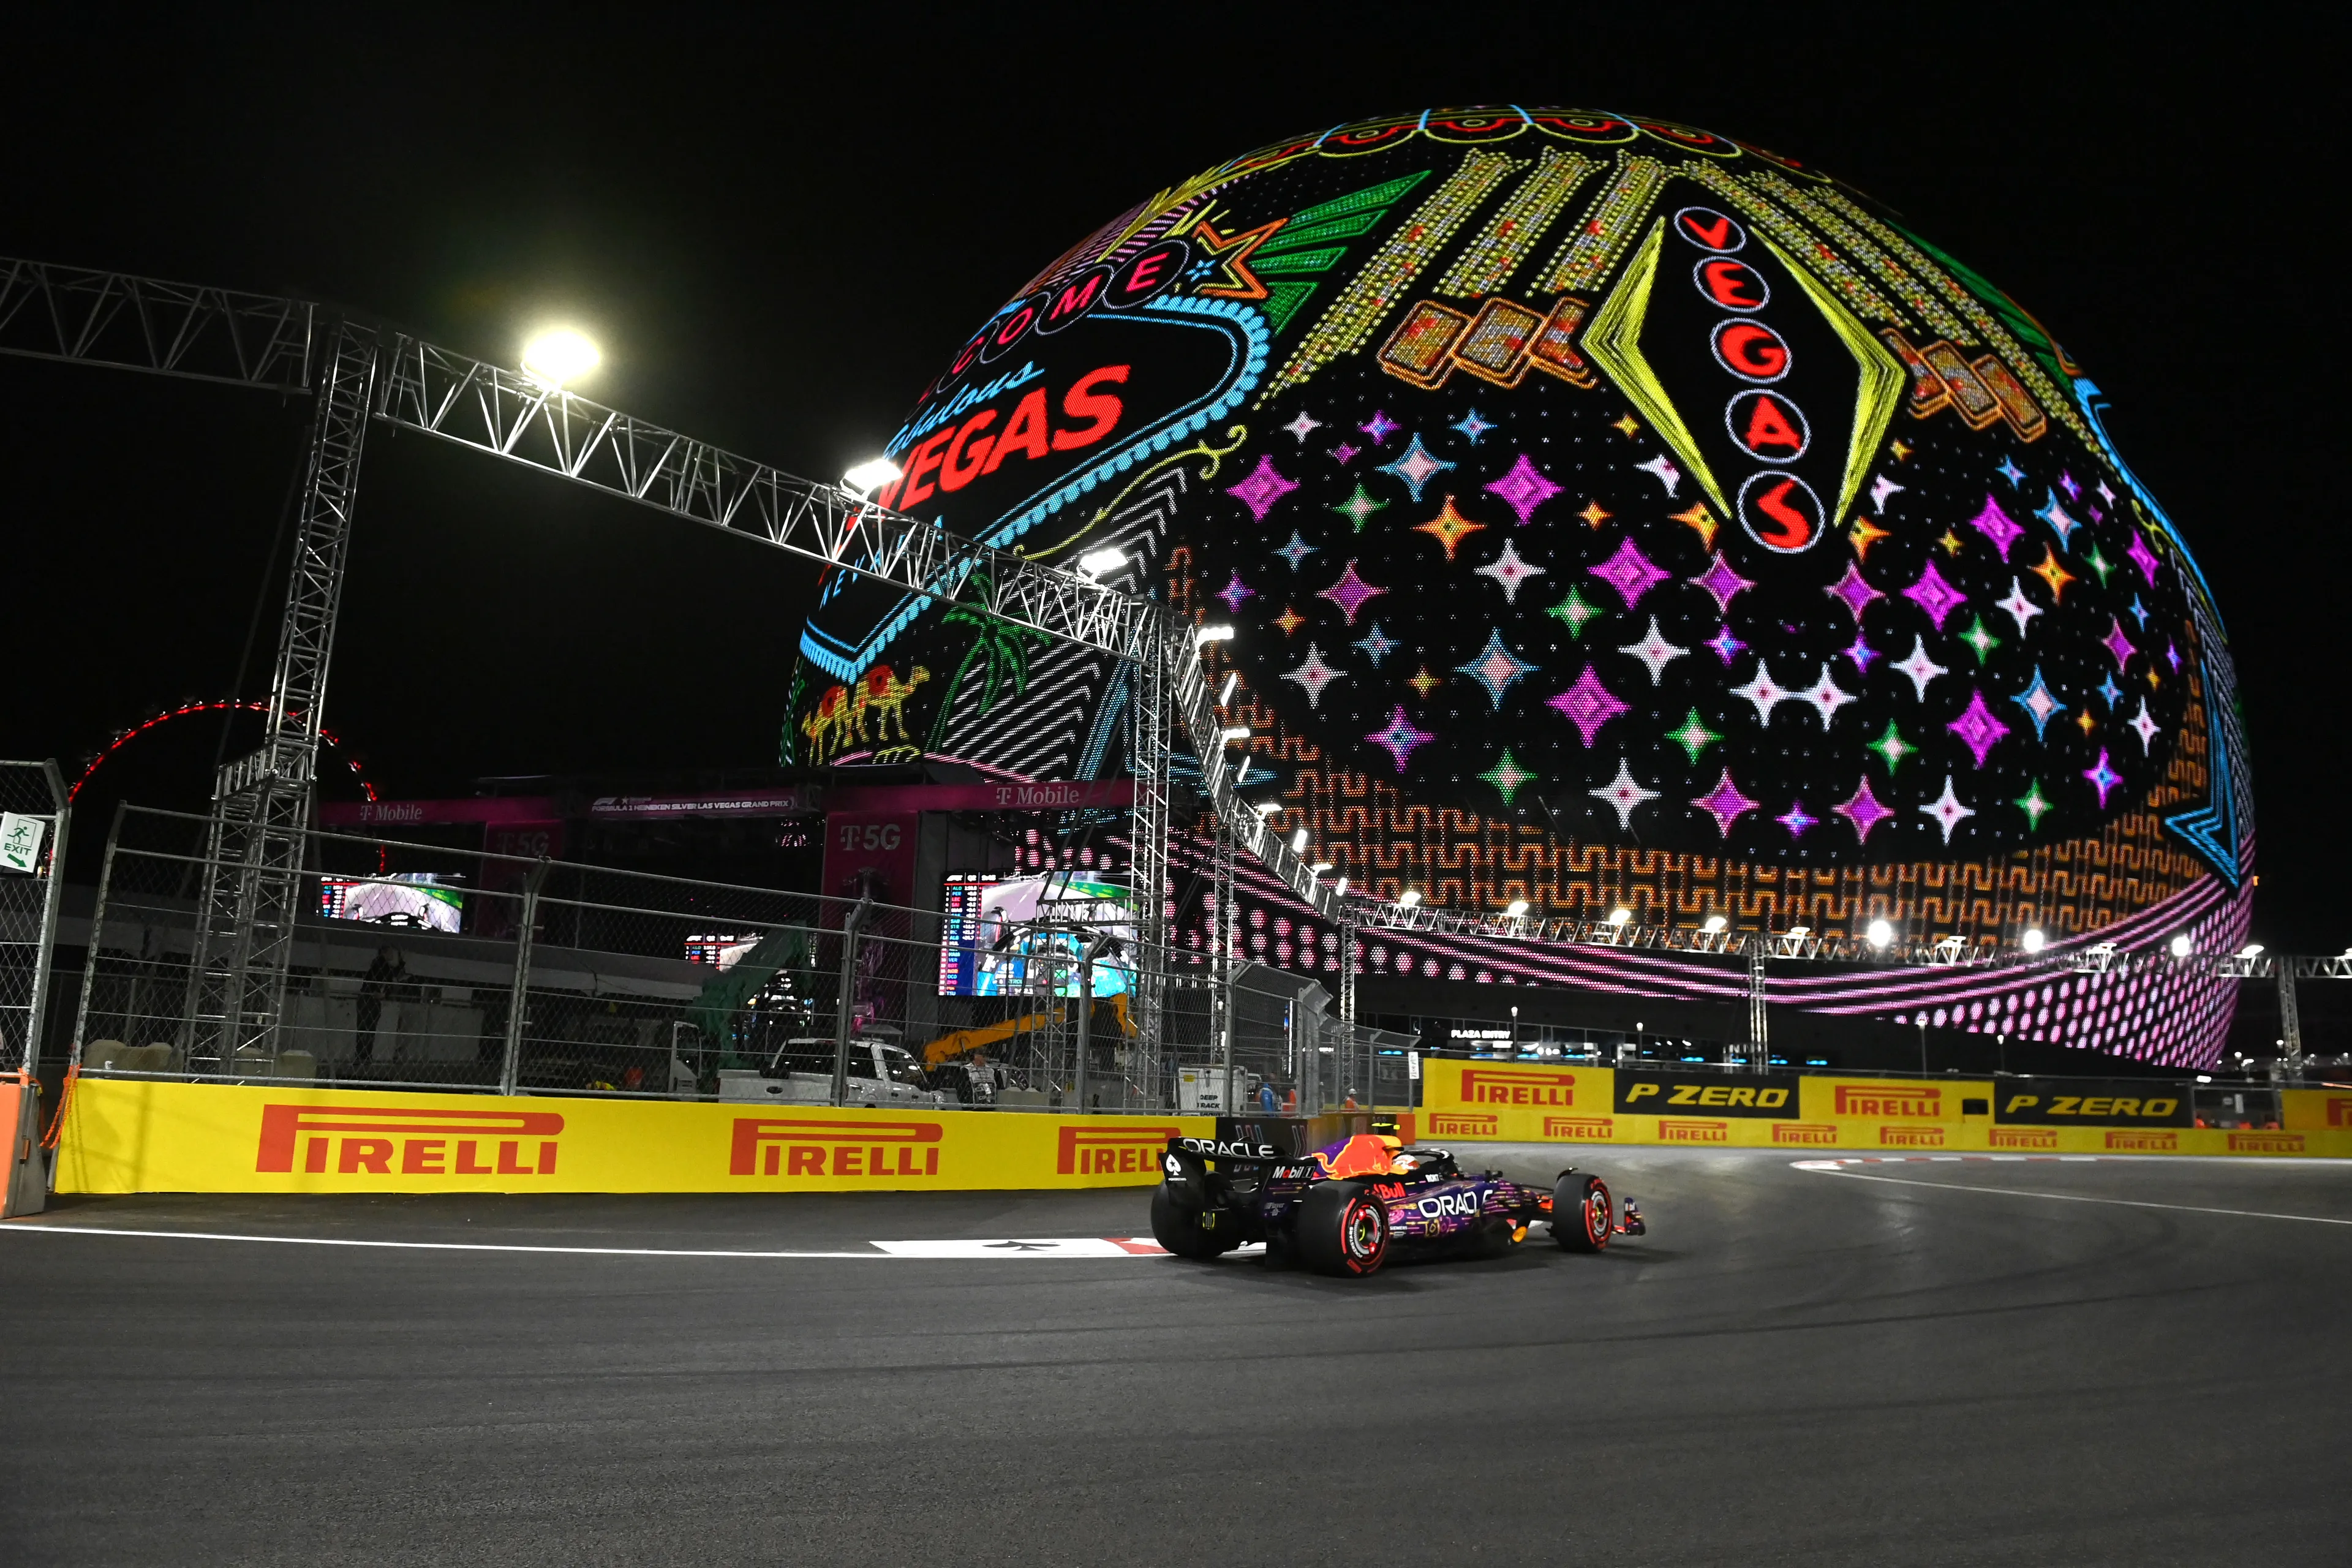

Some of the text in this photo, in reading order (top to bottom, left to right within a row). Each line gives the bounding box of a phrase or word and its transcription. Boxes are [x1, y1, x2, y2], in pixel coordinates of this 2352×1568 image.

[1682, 217, 1810, 549] VEGAS
[878, 364, 1144, 512] VEGAS
[1016, 786, 1080, 805] Mobile
[375, 804, 423, 821] Mobile
[863, 824, 901, 851] 5G
[4, 843, 32, 856] EXIT
[1450, 1029, 1511, 1039] PLAZA ENTRY
[1461, 1069, 1575, 1106] PIRELLI
[1625, 1083, 1790, 1108] P ZERO
[1835, 1085, 1941, 1117] PIRELLI
[2005, 1095, 2179, 1117] P ZERO
[1430, 1113, 1498, 1135] PIRELLI
[1544, 1117, 1613, 1138] PIRELLI
[1659, 1120, 1727, 1141] PIRELLI
[1772, 1123, 1837, 1143] PIRELLI
[255, 1104, 564, 1174] PIRELLI
[1880, 1126, 1944, 1145] PIRELLI
[1989, 1129, 2057, 1148] PIRELLI
[2105, 1131, 2177, 1149] PIRELLI
[2228, 1133, 2305, 1152] PIRELLI
[730, 1118, 943, 1175] PIRELLI
[1057, 1126, 1181, 1174] PIREL
[1183, 1138, 1275, 1159] ORACLE
[1272, 1166, 1305, 1178] Mobil
[1378, 1182, 1407, 1199] Bull
